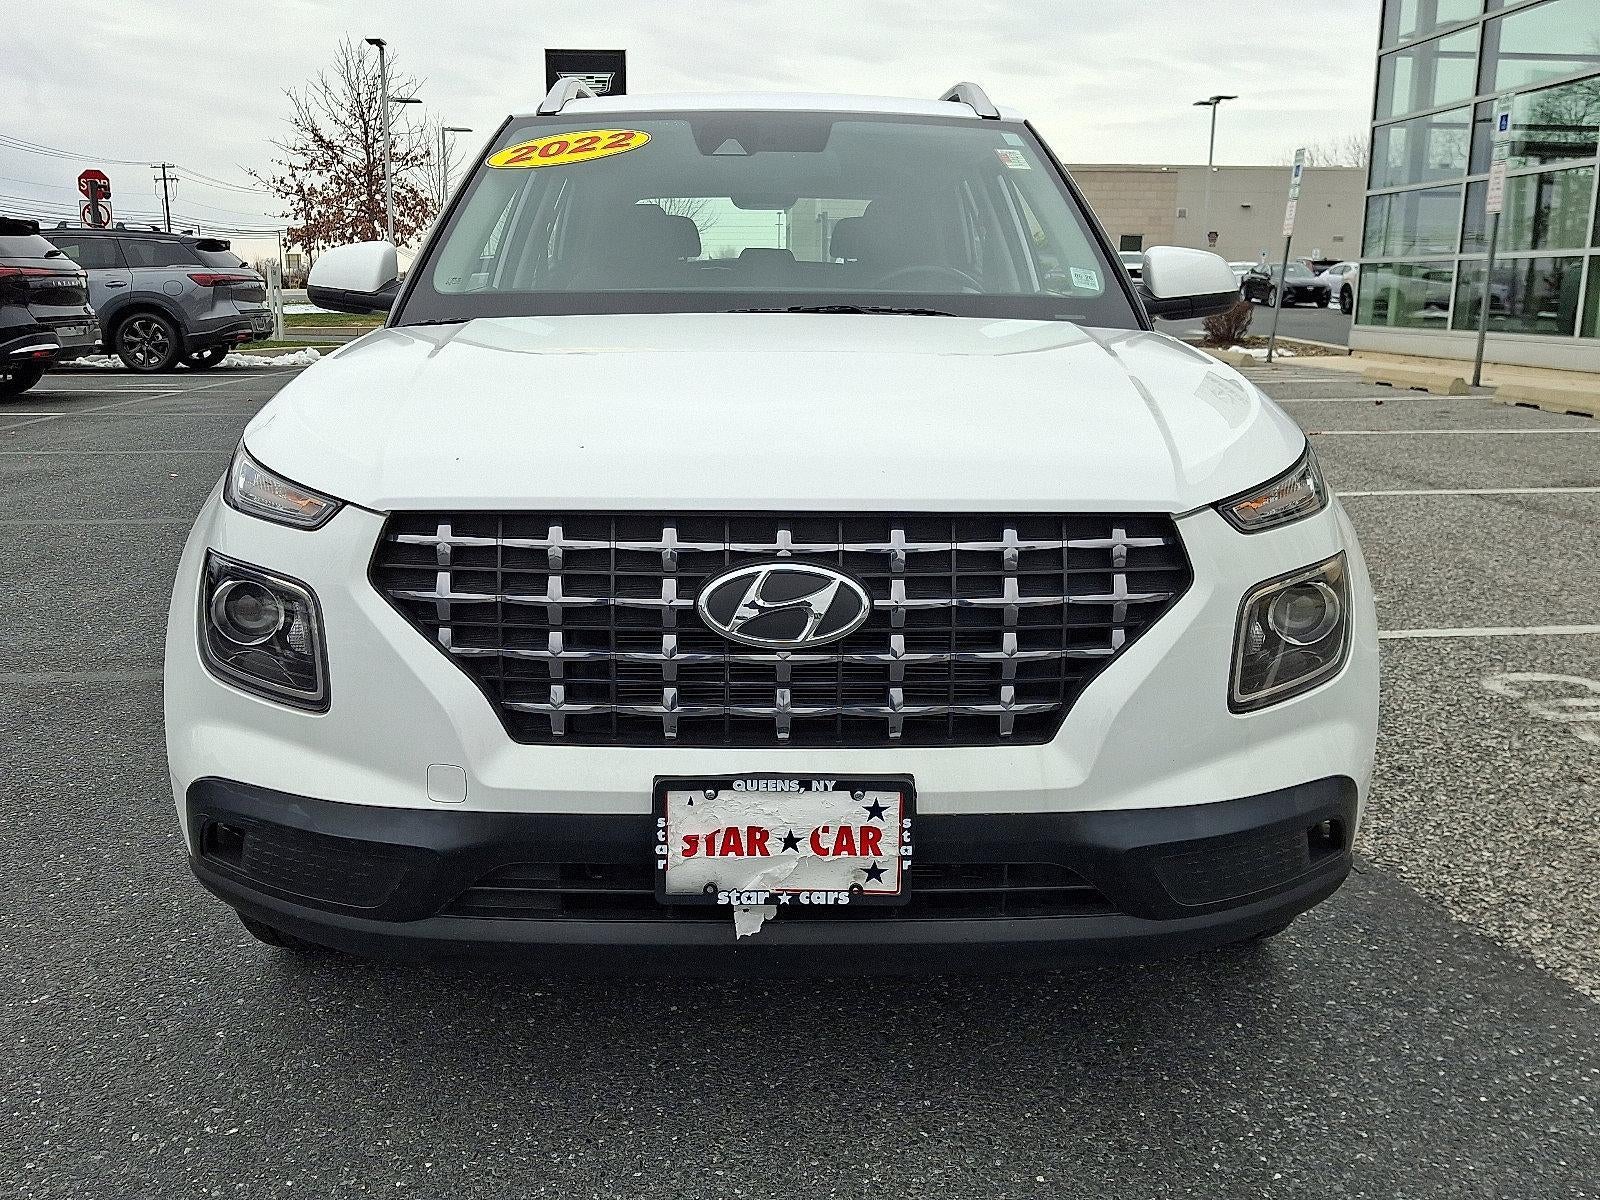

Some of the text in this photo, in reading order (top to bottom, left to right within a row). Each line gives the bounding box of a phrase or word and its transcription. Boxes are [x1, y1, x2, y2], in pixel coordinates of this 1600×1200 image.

[502, 132, 637, 165] 2022
[80, 178, 108, 191] SP
[732, 779, 837, 794] QUEENS, NY
[681, 825, 883, 857] STAR CAR
[717, 887, 850, 905] star cars
